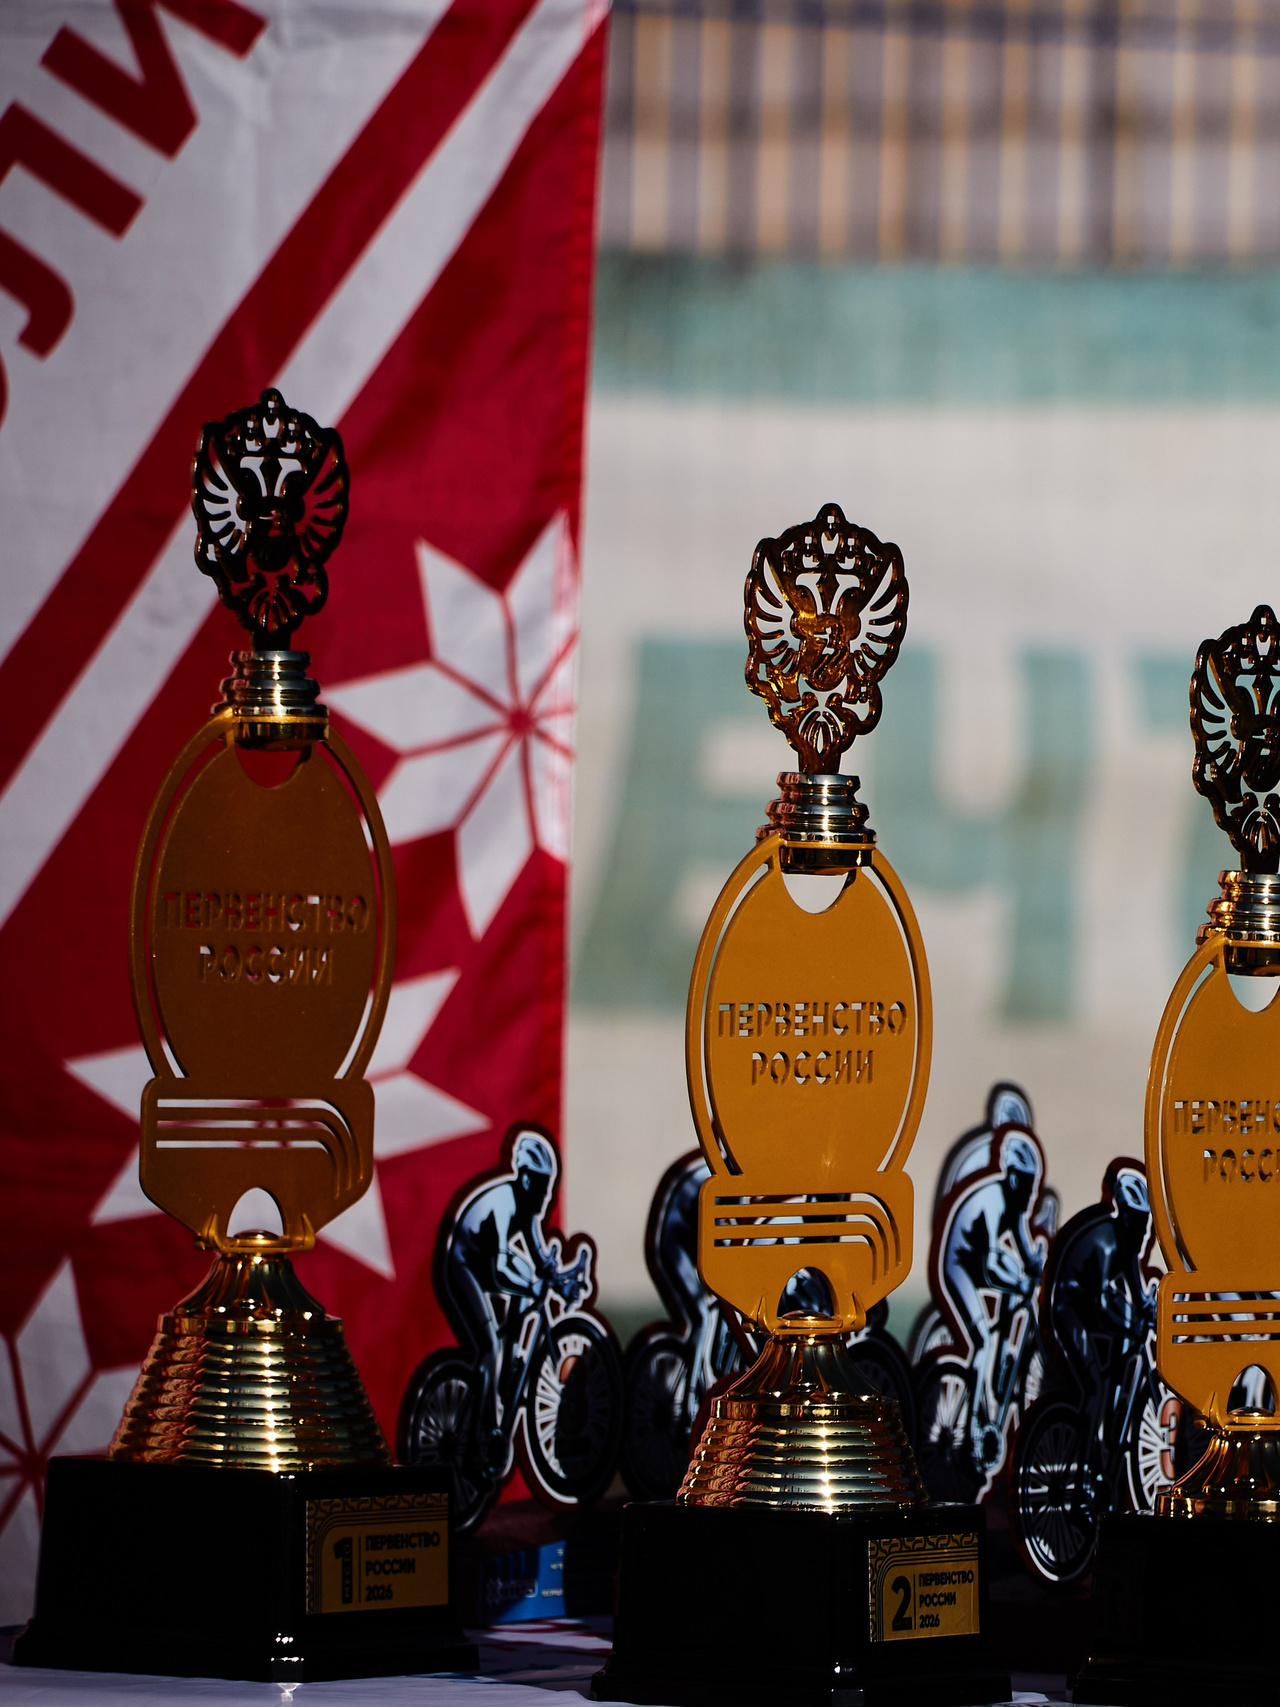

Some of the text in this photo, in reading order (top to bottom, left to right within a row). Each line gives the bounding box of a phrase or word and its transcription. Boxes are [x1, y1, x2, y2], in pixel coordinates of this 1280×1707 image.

[164, 892, 369, 933] ПЕРВЕНСТВО
[200, 945, 333, 984] РОССИИ
[718, 1001, 907, 1037] ПЕРВЕНСТВО
[752, 1051, 874, 1085] РОССИИ
[366, 1532, 440, 1551] ПЕРВЕНСТВО
[333, 1537, 352, 1604] 1
[366, 1558, 415, 1577] РОССИИ
[919, 1570, 974, 1587] ПЕРВЕНСТВО
[365, 1585, 393, 1601] 2026
[892, 1575, 913, 1631] 2
[919, 1592, 957, 1608] РОССИИ
[919, 1614, 940, 1629] 2026
